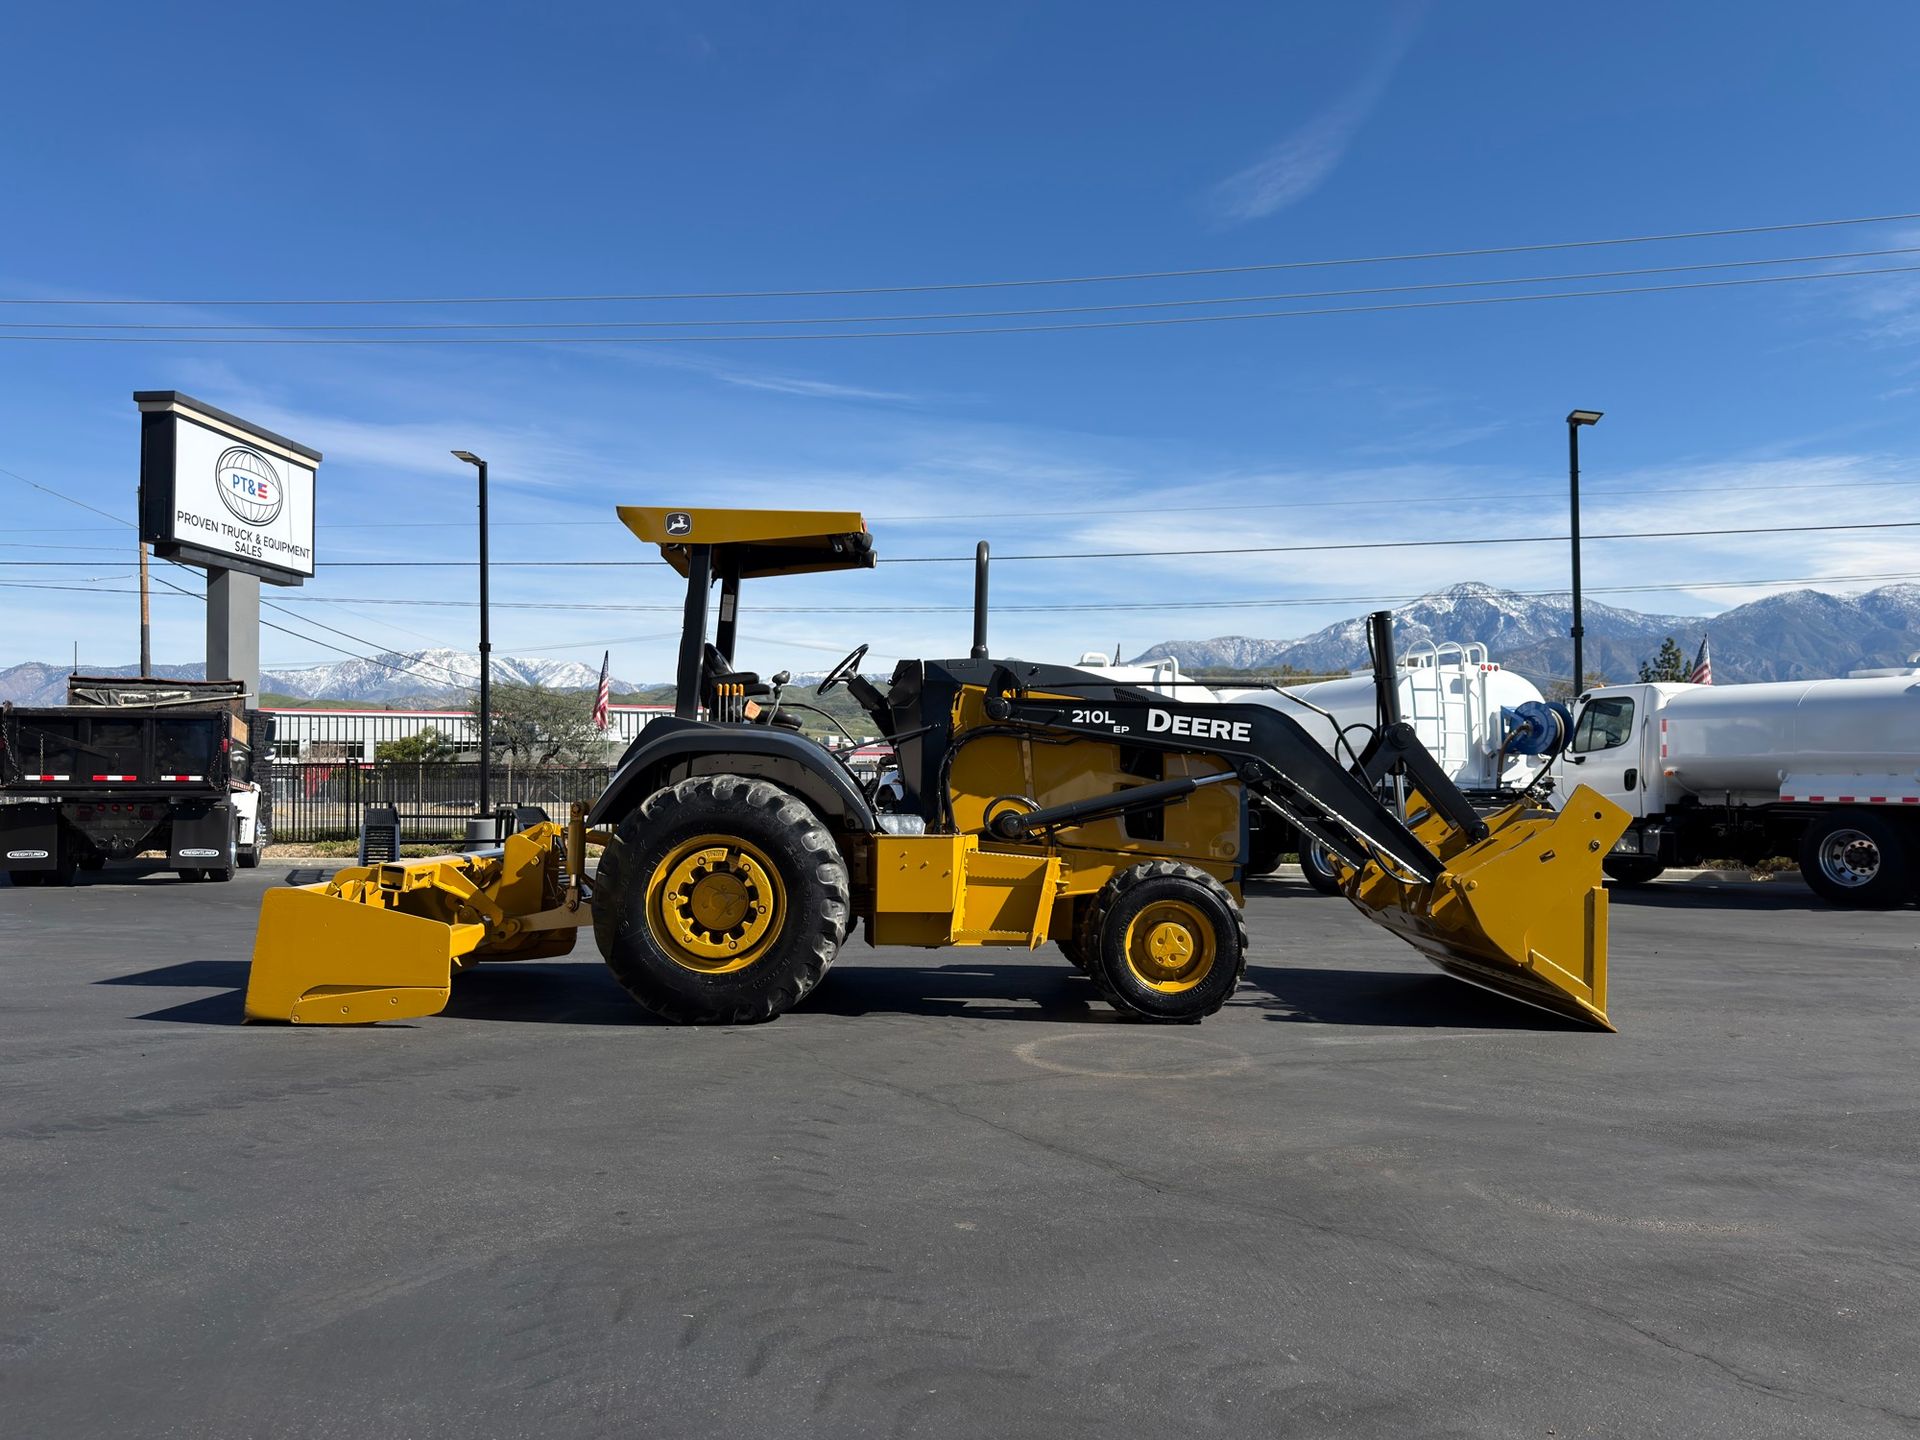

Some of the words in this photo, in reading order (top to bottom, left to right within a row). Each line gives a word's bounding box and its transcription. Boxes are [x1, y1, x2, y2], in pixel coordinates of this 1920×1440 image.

[232, 473, 268, 499] PT&E
[177, 510, 219, 533] PROVEN
[221, 523, 252, 544] TRUCK
[255, 534, 262, 544] &
[263, 536, 311, 559] EQUIPMENT
[234, 540, 263, 558] SALES
[1071, 709, 1116, 724] 210L
[1113, 725, 1130, 734] EP
[1146, 708, 1252, 742] DEERE
